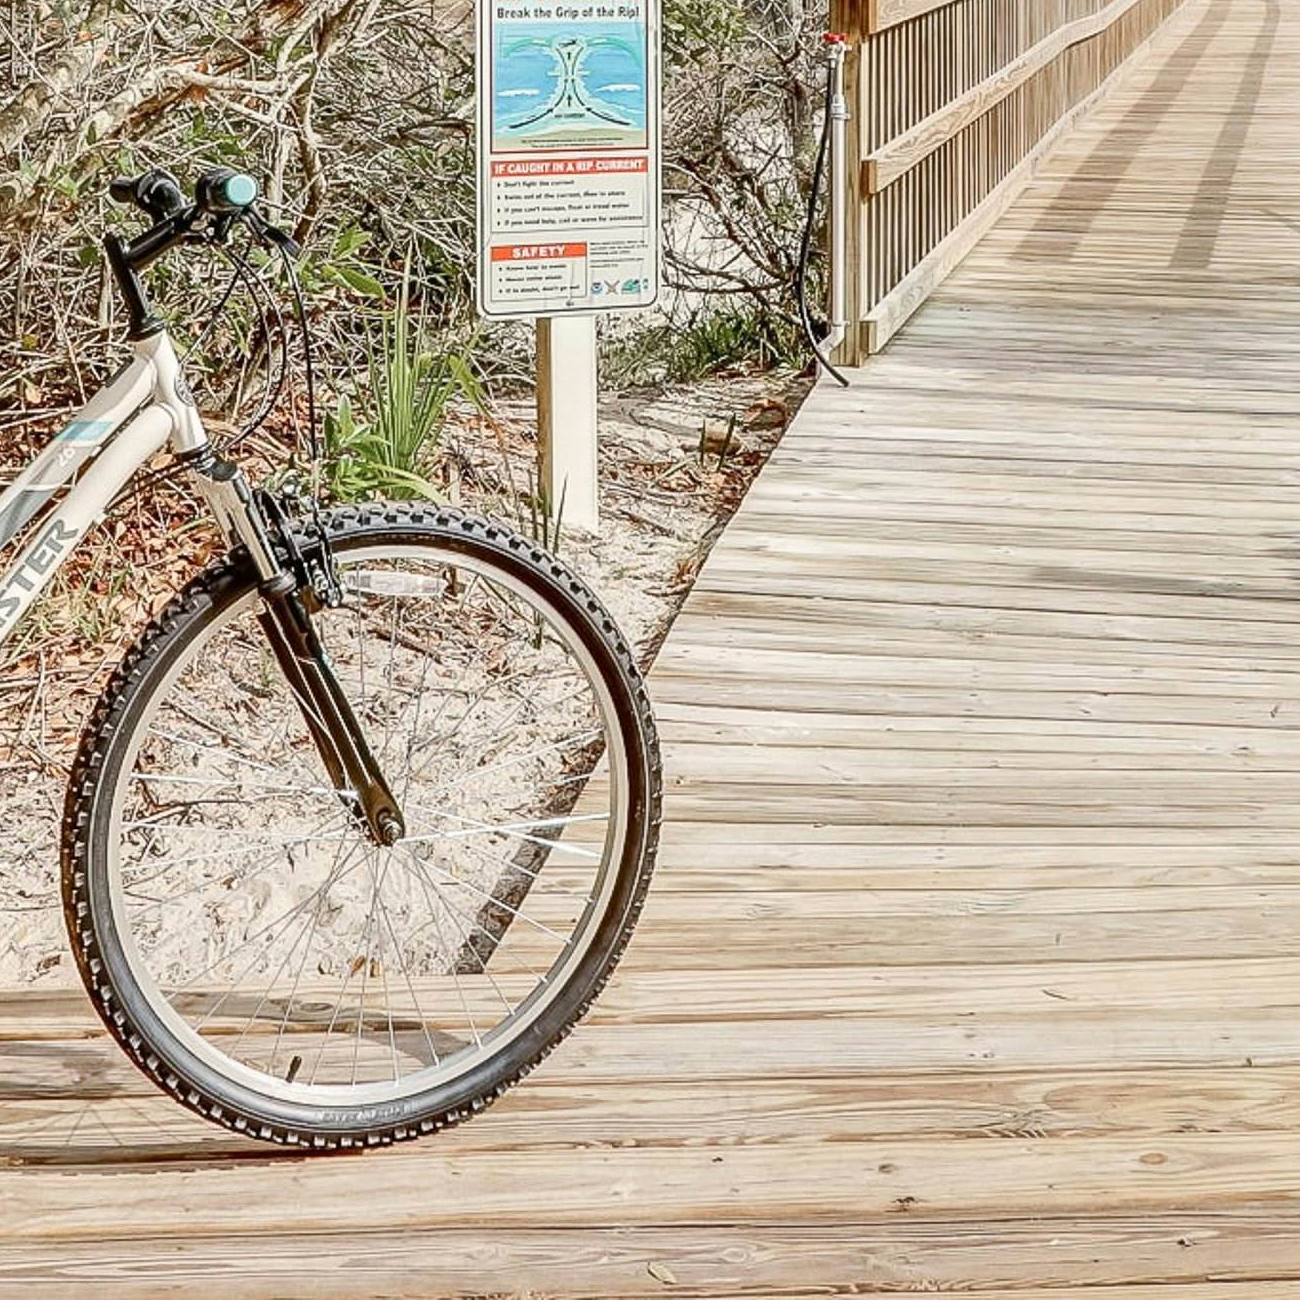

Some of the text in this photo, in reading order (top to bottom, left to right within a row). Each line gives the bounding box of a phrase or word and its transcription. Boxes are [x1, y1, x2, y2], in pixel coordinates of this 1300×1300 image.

[497, 7, 531, 19] Break
[534, 7, 551, 18] the
[555, 6, 578, 20] Grip
[582, 6, 593, 18] of
[597, 6, 614, 18] the
[494, 163, 505, 174] IF
[507, 162, 550, 173] CAUGHT
[553, 162, 565, 172] IN
[567, 161, 575, 172] A
[511, 245, 566, 259] SAFETY
